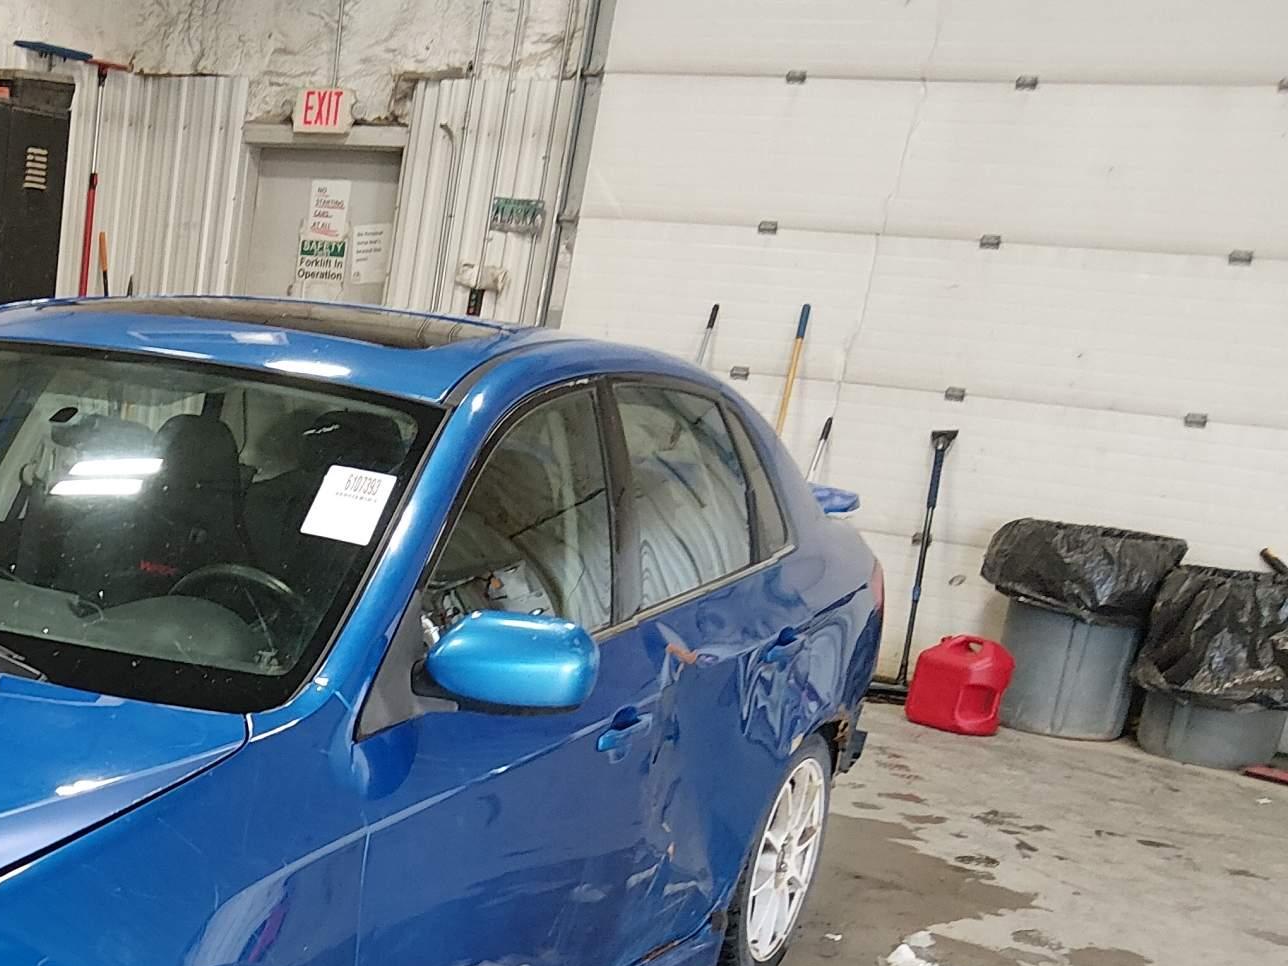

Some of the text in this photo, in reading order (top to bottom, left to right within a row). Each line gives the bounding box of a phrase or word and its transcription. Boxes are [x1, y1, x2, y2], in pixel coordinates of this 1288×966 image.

[303, 90, 344, 127] EXIT
[303, 240, 344, 252] SAFETY
[299, 257, 343, 269] Forklift In
[297, 268, 343, 280] Operation
